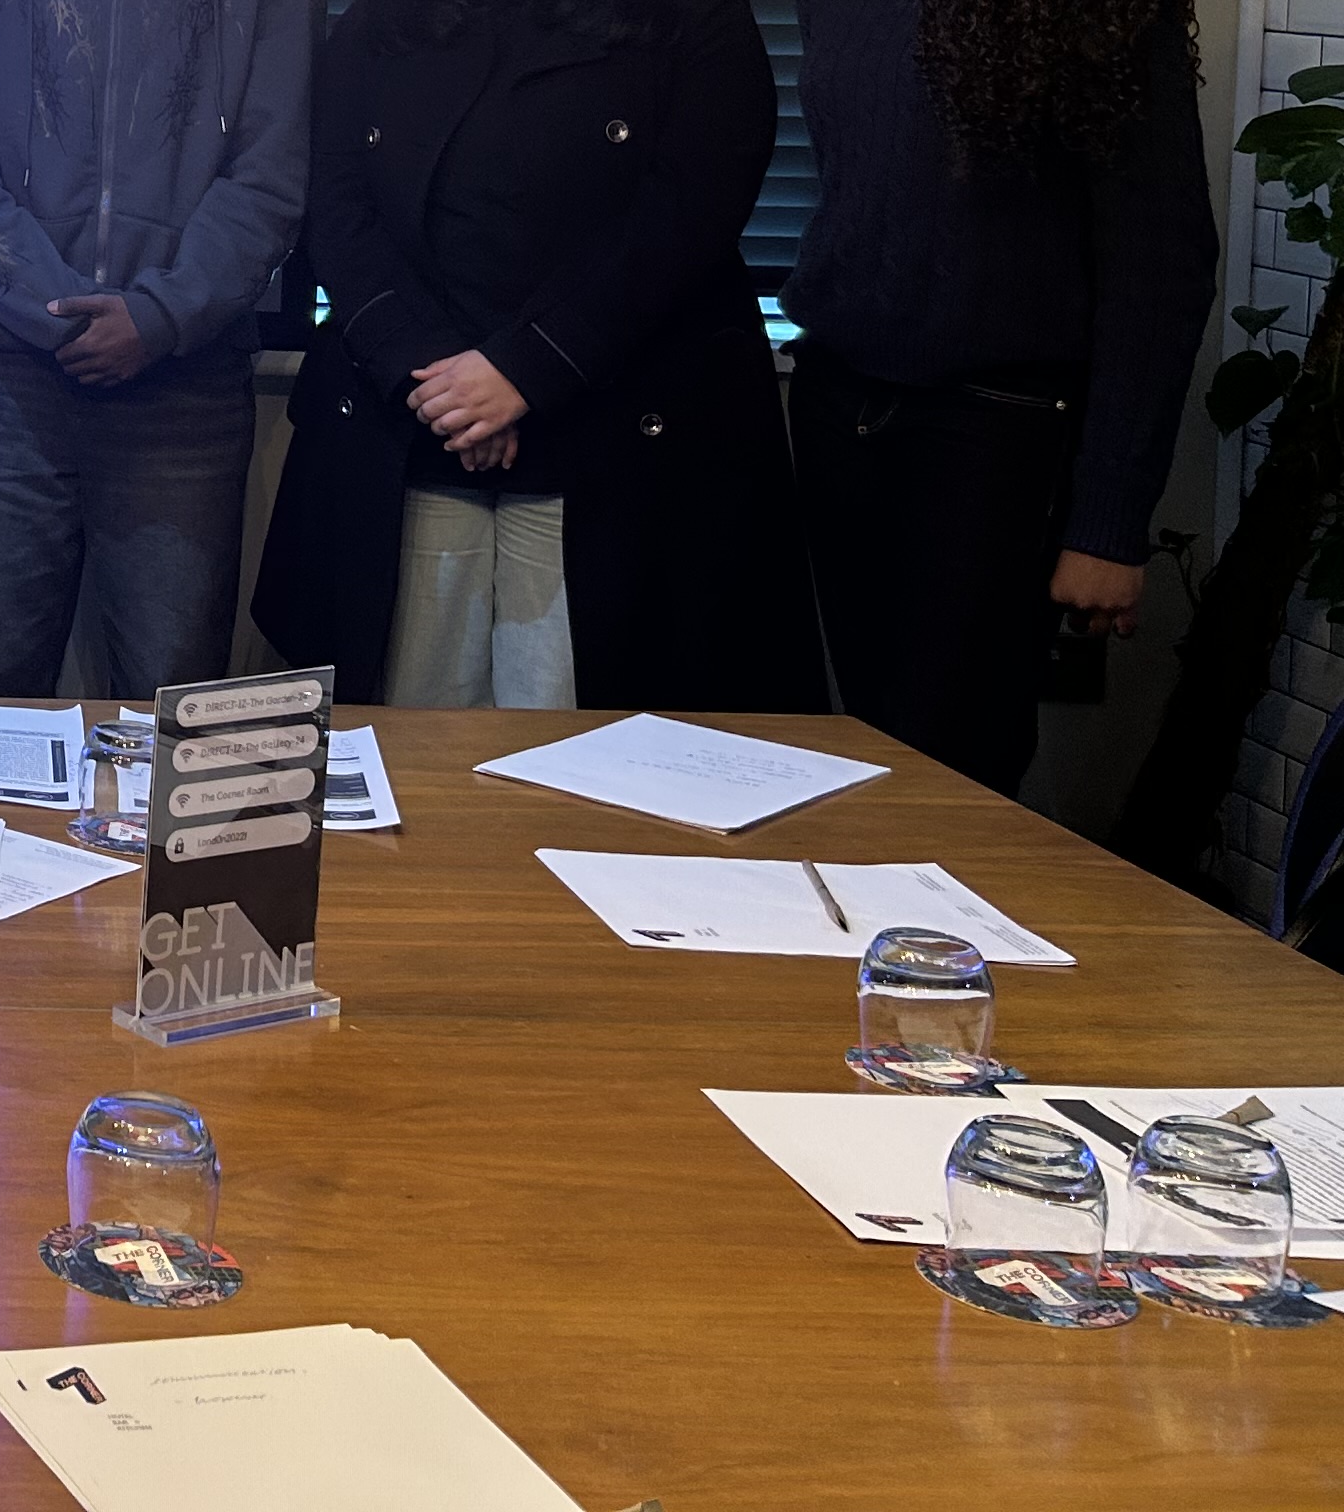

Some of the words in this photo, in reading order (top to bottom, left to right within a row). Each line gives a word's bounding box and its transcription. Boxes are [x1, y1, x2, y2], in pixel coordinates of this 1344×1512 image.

[200, 793, 215, 804] The
[216, 790, 246, 801] Corner
[247, 785, 270, 797] Room
[140, 901, 237, 962] GET
[140, 941, 315, 1016] ONLINE
[112, 1248, 146, 1263] THE
[146, 1244, 175, 1284] CORNER
[994, 1269, 1026, 1285] THE
[1023, 1266, 1073, 1305] CORNER
